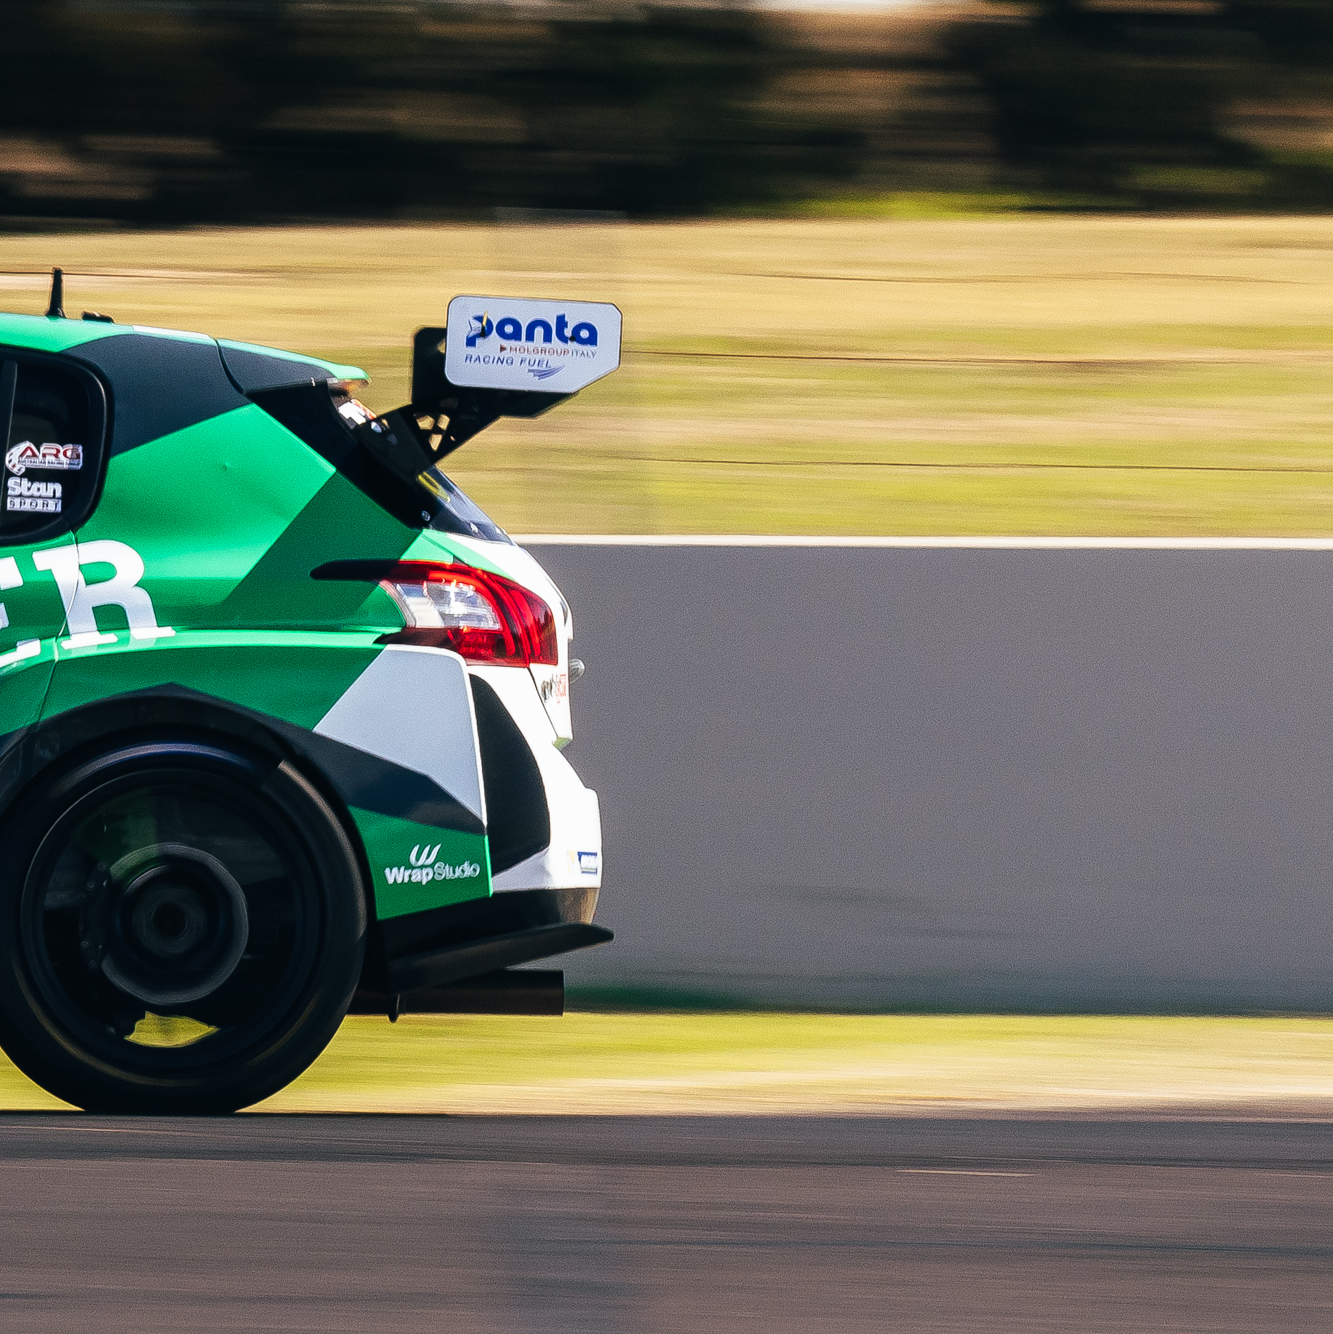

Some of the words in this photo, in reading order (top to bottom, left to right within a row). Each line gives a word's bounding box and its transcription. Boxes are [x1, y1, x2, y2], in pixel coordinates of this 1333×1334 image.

[465, 313, 599, 348] panta
[464, 353, 514, 366] RACING
[519, 357, 552, 369] FUEL
[7, 476, 62, 498] Stan
[8, 498, 62, 512] SPORT
